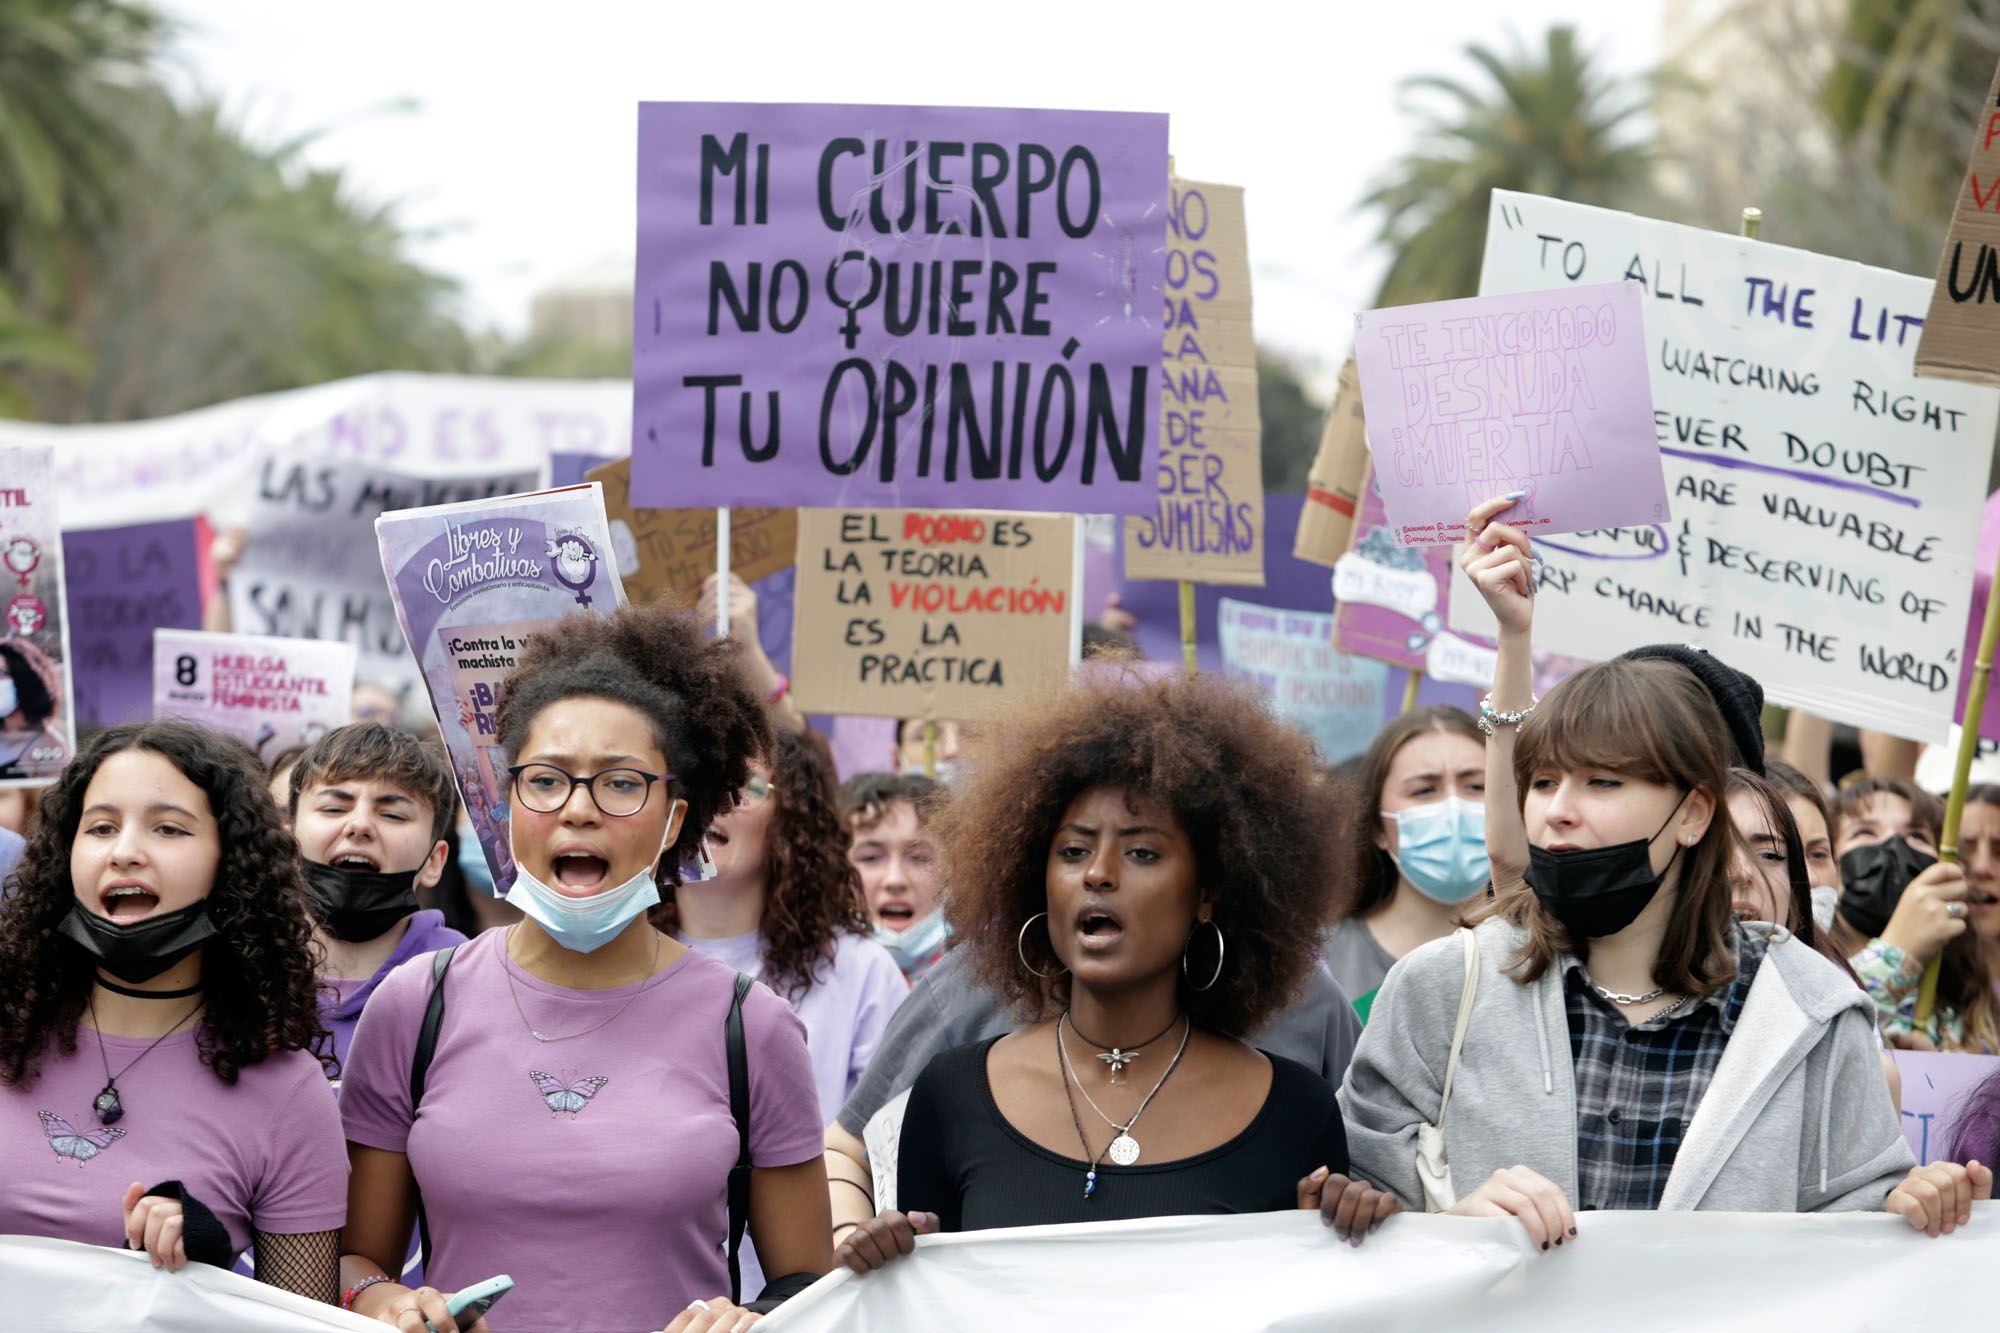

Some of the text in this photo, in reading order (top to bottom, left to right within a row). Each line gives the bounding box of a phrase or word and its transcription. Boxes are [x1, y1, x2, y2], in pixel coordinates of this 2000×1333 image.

[699, 132, 1101, 238] MI CUERPO
[707, 259, 809, 336] NO
[1624, 253, 1704, 306] ALL
[1744, 276, 1815, 330] THE
[1380, 303, 1616, 369] TE INCOMODO
[819, 337, 1149, 485] OPINIÓN
[1401, 348, 1597, 427] DESNUDA
[1661, 339, 1968, 433] WATCHING RIGHT
[1167, 410, 1206, 449] DE
[1780, 431, 1928, 490] DOUBT
[443, 517, 502, 571] Libres
[508, 527, 523, 555] y
[841, 512, 1033, 548] EL PORNO ES
[1675, 475, 1943, 564] ARE VALUABLE
[423, 547, 544, 604] Combativas
[824, 548, 989, 578] LA TEORIA
[1706, 537, 1885, 604] DESERVING
[1900, 591, 1947, 624] OF
[836, 577, 1066, 615] LA VIOLACIÓN
[1595, 576, 1711, 628] CHANCE
[1734, 611, 1762, 640] IN
[1775, 623, 1840, 662] THE
[448, 637, 500, 656] ¡Contra
[500, 635, 516, 650] la
[458, 654, 516, 669] machista
[845, 618, 961, 646] ES LA
[176, 655, 197, 686] 8
[212, 653, 287, 672] HUELGA
